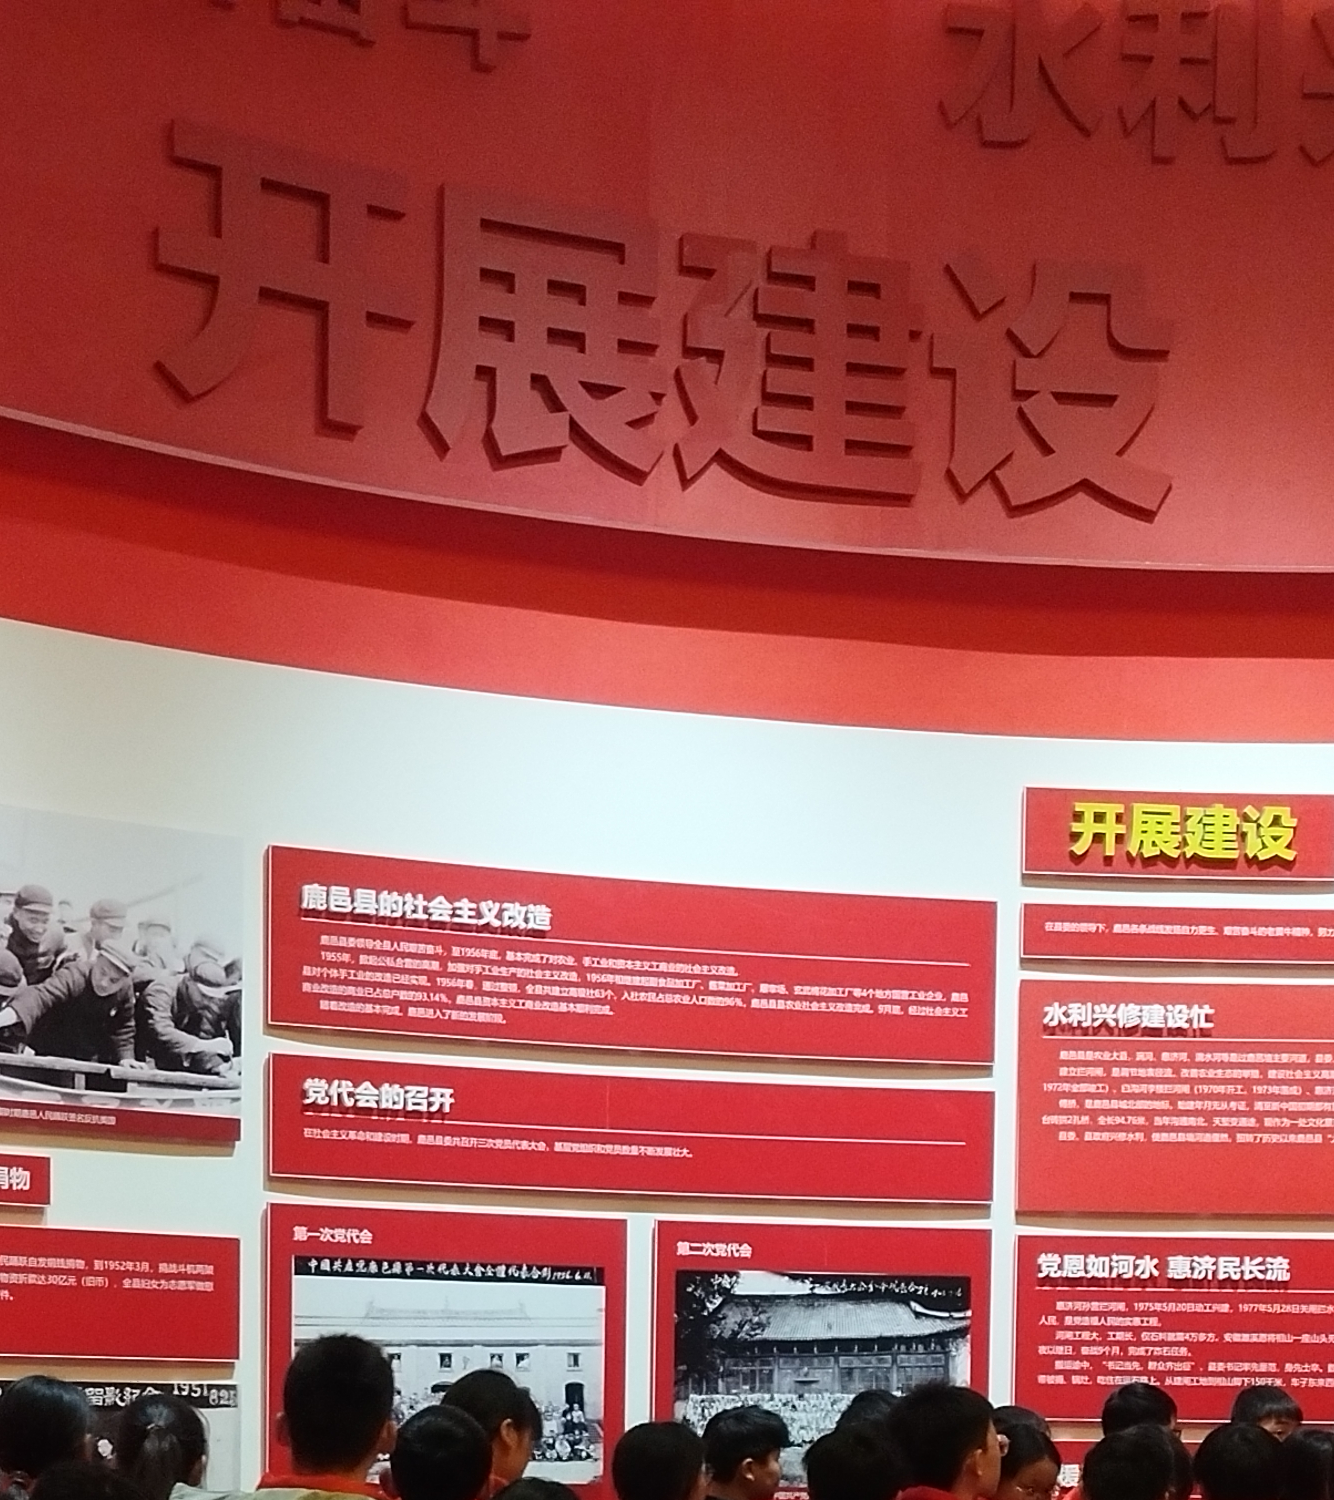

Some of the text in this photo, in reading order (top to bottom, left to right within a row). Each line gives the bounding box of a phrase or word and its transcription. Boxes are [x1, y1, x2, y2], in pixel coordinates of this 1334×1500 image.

[153, 116, 1174, 523] 开展建设
[1070, 801, 1298, 863] 开展建设
[301, 883, 551, 933] 鹿邑县的社会主义改造
[1043, 1002, 1215, 1029] 水利兴修建设忙
[302, 1078, 455, 1113] 党代会的召开
[292, 1226, 373, 1245] 第一次党代会
[676, 1241, 752, 1259] 第二次党代会
[1037, 1252, 1291, 1281] 党恩如河水 惠济民长流
